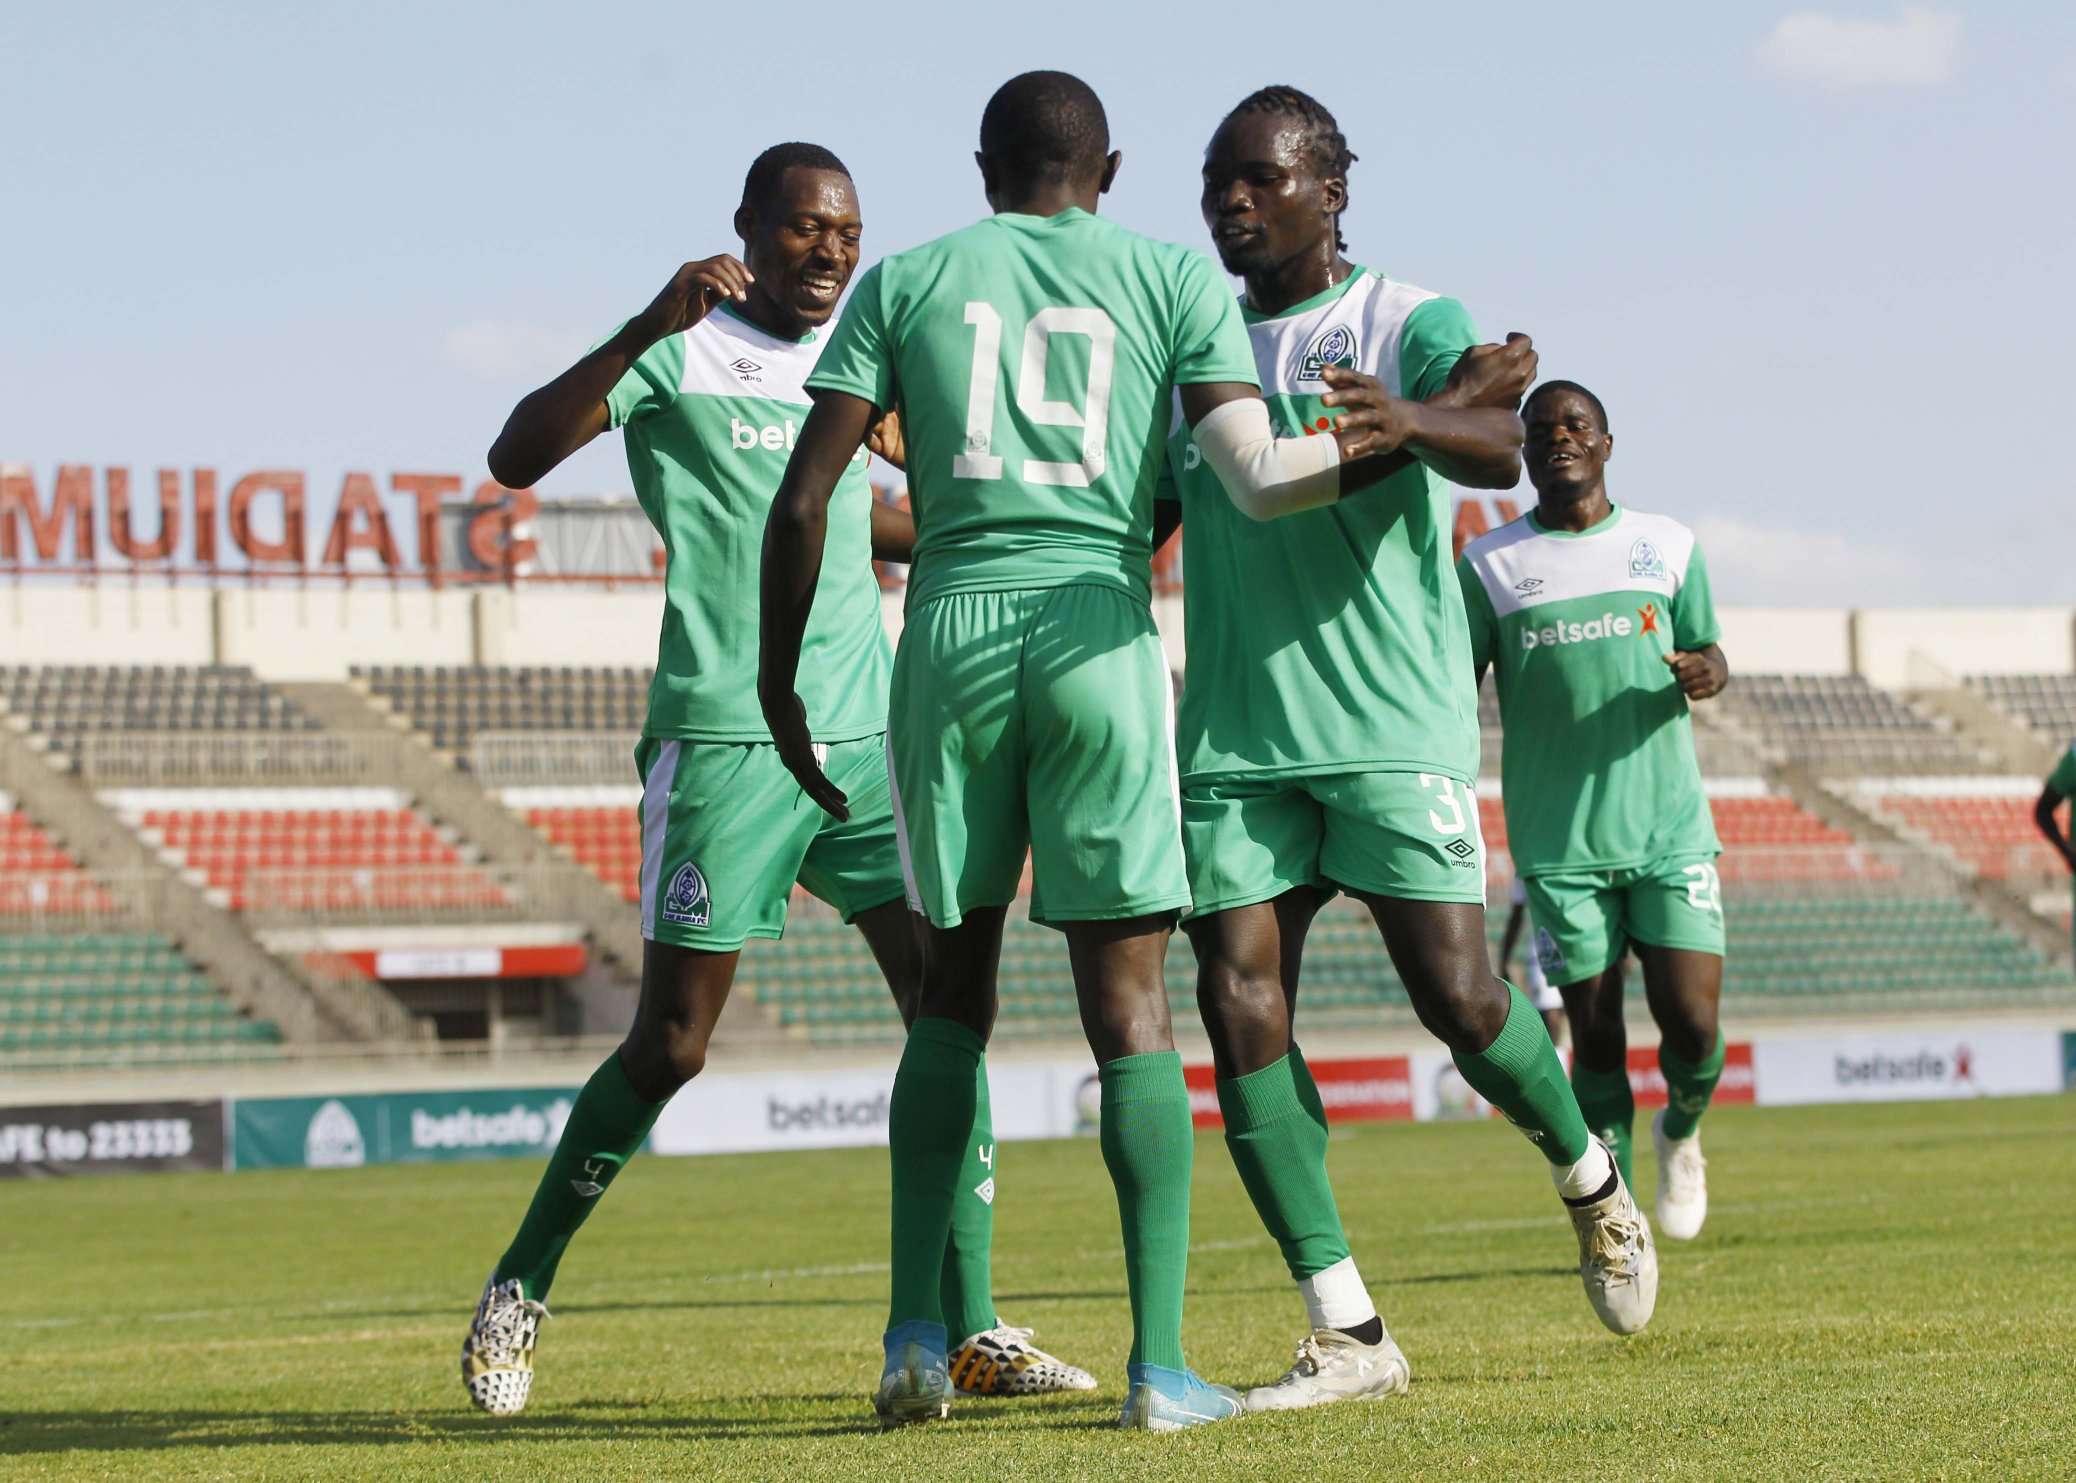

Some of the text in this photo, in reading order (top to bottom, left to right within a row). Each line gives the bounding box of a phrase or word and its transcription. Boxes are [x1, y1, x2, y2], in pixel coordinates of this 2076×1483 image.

[953, 302, 1116, 487] 19
[1521, 612, 1632, 650] betsafe
[1419, 772, 1466, 835] 3
[1450, 859, 1476, 870] umbro
[1835, 1052, 1944, 1085] betsafe
[411, 1106, 545, 1148] betsafe
[767, 1090, 889, 1130] betsaf
[46, 1125, 87, 1161] to
[88, 1118, 193, 1160] 23333
[979, 1144, 993, 1171] 4
[584, 1159, 604, 1180] 4
